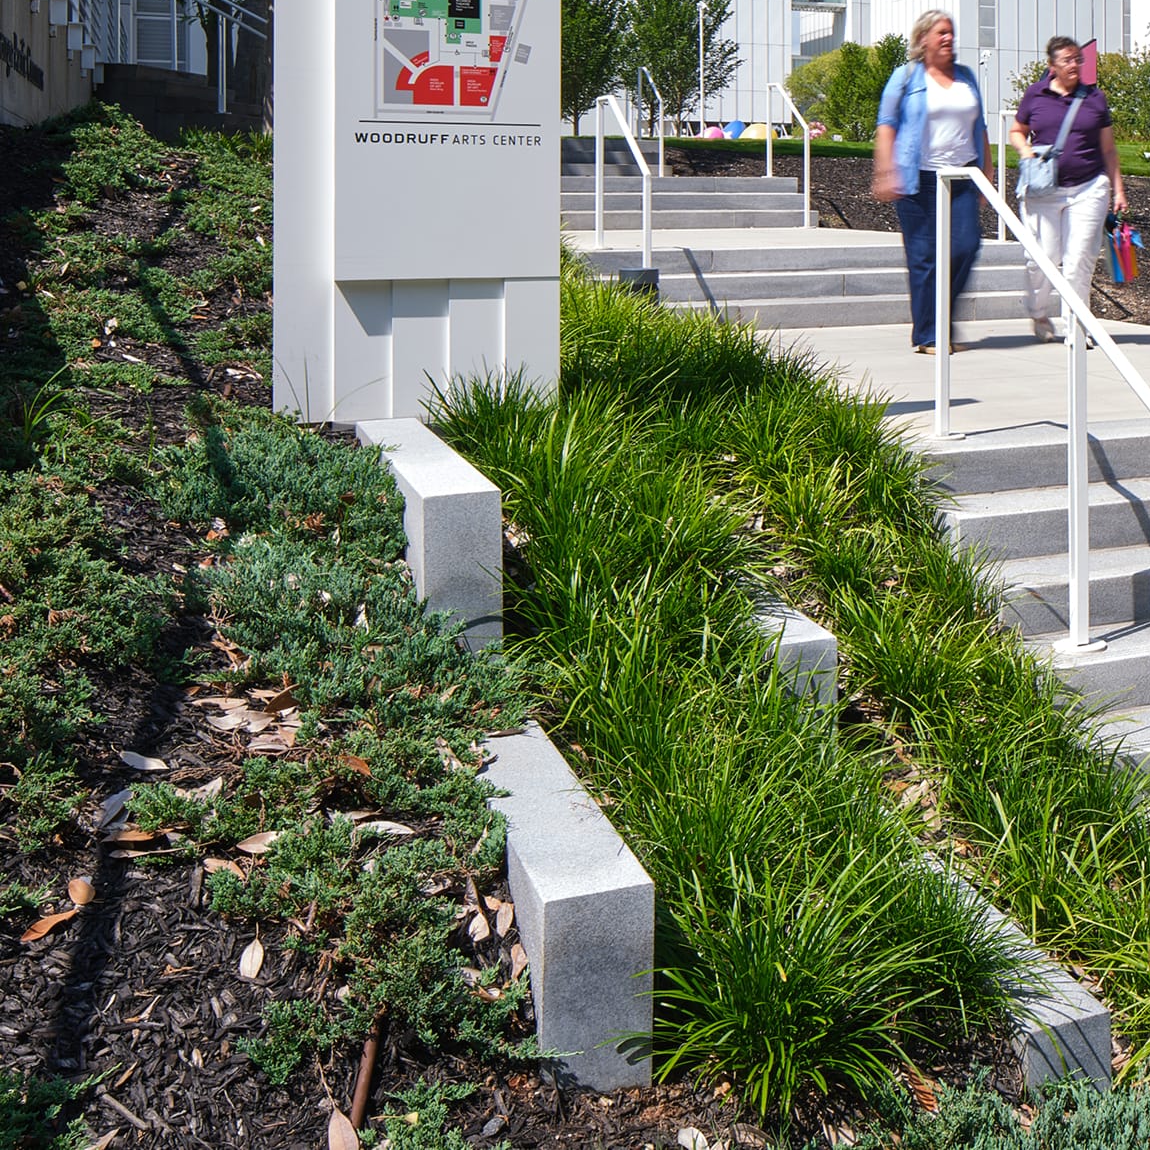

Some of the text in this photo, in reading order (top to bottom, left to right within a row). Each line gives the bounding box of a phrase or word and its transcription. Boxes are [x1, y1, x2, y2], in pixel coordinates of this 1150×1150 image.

[354, 131, 542, 148] WOODRUFF ARTS CENTER
